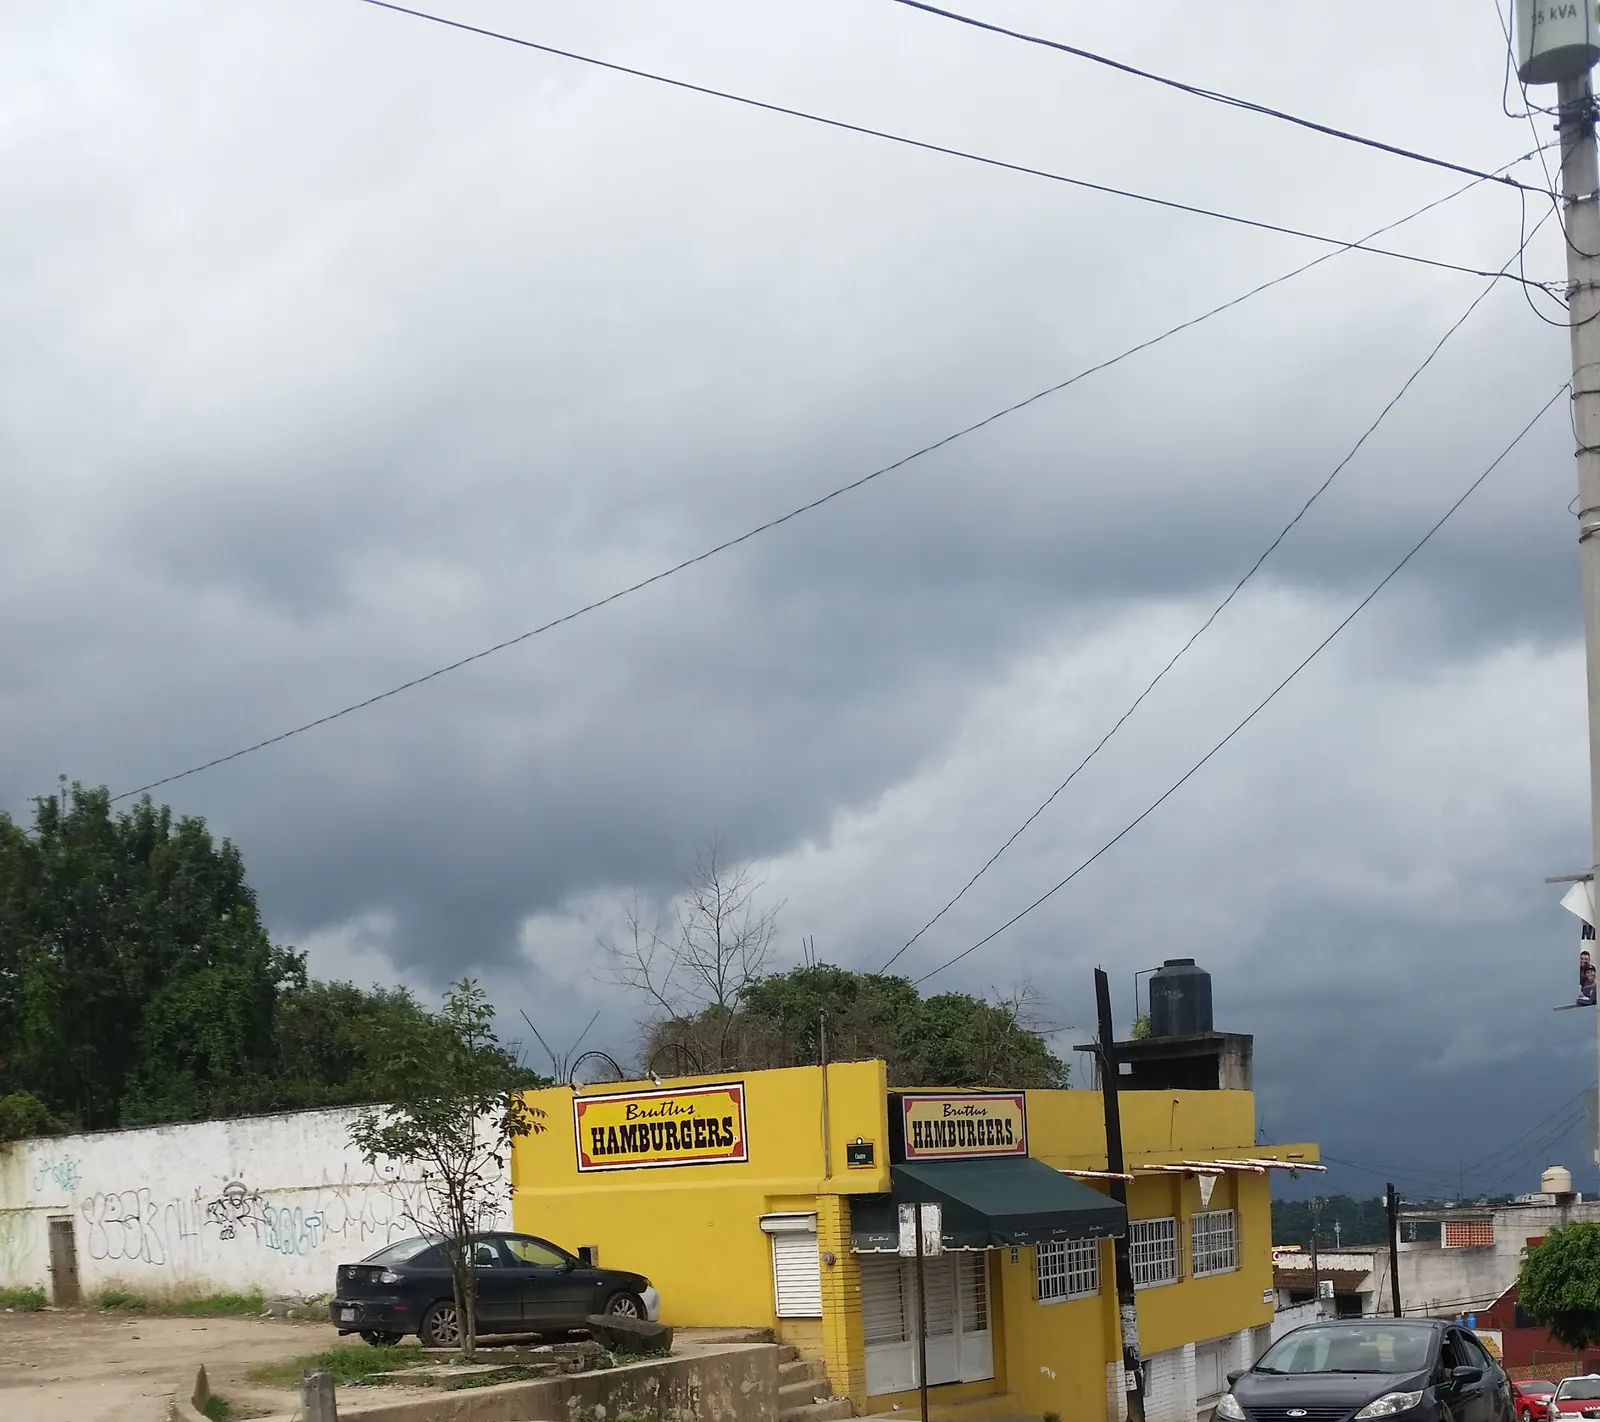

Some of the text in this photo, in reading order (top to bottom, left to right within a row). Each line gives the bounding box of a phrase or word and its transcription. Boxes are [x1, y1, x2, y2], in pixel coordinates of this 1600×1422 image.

[1550, 4, 1577, 20] kVA
[625, 1100, 696, 1121] Bruttus
[942, 1103, 989, 1118] Bruttus
[591, 1116, 734, 1156] HAMBURGERS
[912, 1118, 1013, 1149] HAMBURGERS
